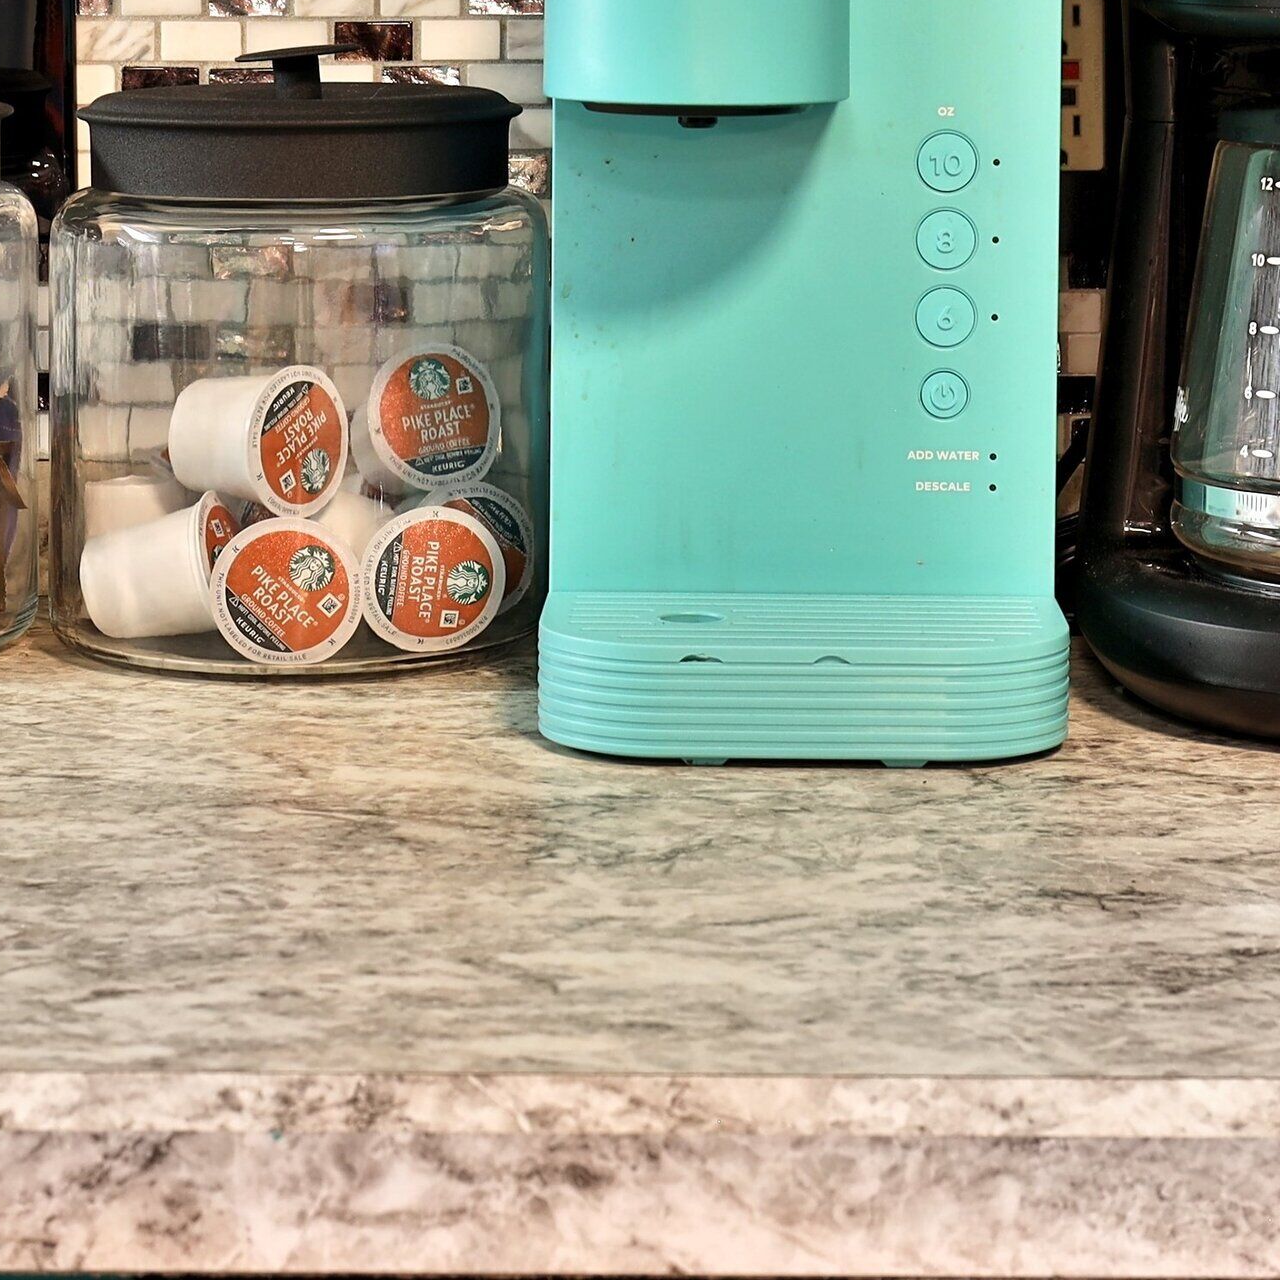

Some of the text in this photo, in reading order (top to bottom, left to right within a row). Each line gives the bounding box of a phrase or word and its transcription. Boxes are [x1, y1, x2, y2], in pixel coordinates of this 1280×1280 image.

[938, 106, 955, 116] OZ
[929, 153, 963, 178] 10
[1260, 178, 1273, 191] 12
[935, 230, 955, 254] 8
[1251, 254, 1265, 267] 10
[936, 306, 954, 332] 6
[1248, 322, 1258, 336] 8
[272, 387, 295, 412] KEURIG
[1244, 386, 1253, 400] 6
[284, 407, 314, 444] ROAST
[307, 410, 327, 436] PIKE
[402, 406, 471, 432] PIKE PLACE
[420, 421, 460, 443] ROAST
[276, 434, 308, 465] PLACE
[907, 450, 980, 462] ADD WATER
[1240, 444, 1249, 458] 4
[432, 460, 464, 473] KEURIG
[916, 481, 970, 492] DESCALE
[378, 560, 388, 595] KEURIG
[397, 550, 410, 607] GROUND COFFEE
[408, 556, 425, 602] ROAST
[418, 541, 440, 619] PIKE PLACE
[251, 565, 315, 628] PIKE PLACE
[252, 586, 294, 625] ROAST
[241, 593, 286, 638] GROUND COFFEE
[218, 607, 227, 623] NOT
[248, 645, 262, 658] FOR
[263, 653, 287, 662] RETAIL
[288, 652, 307, 662] SALE
[236, 617, 265, 644] KEURIG
